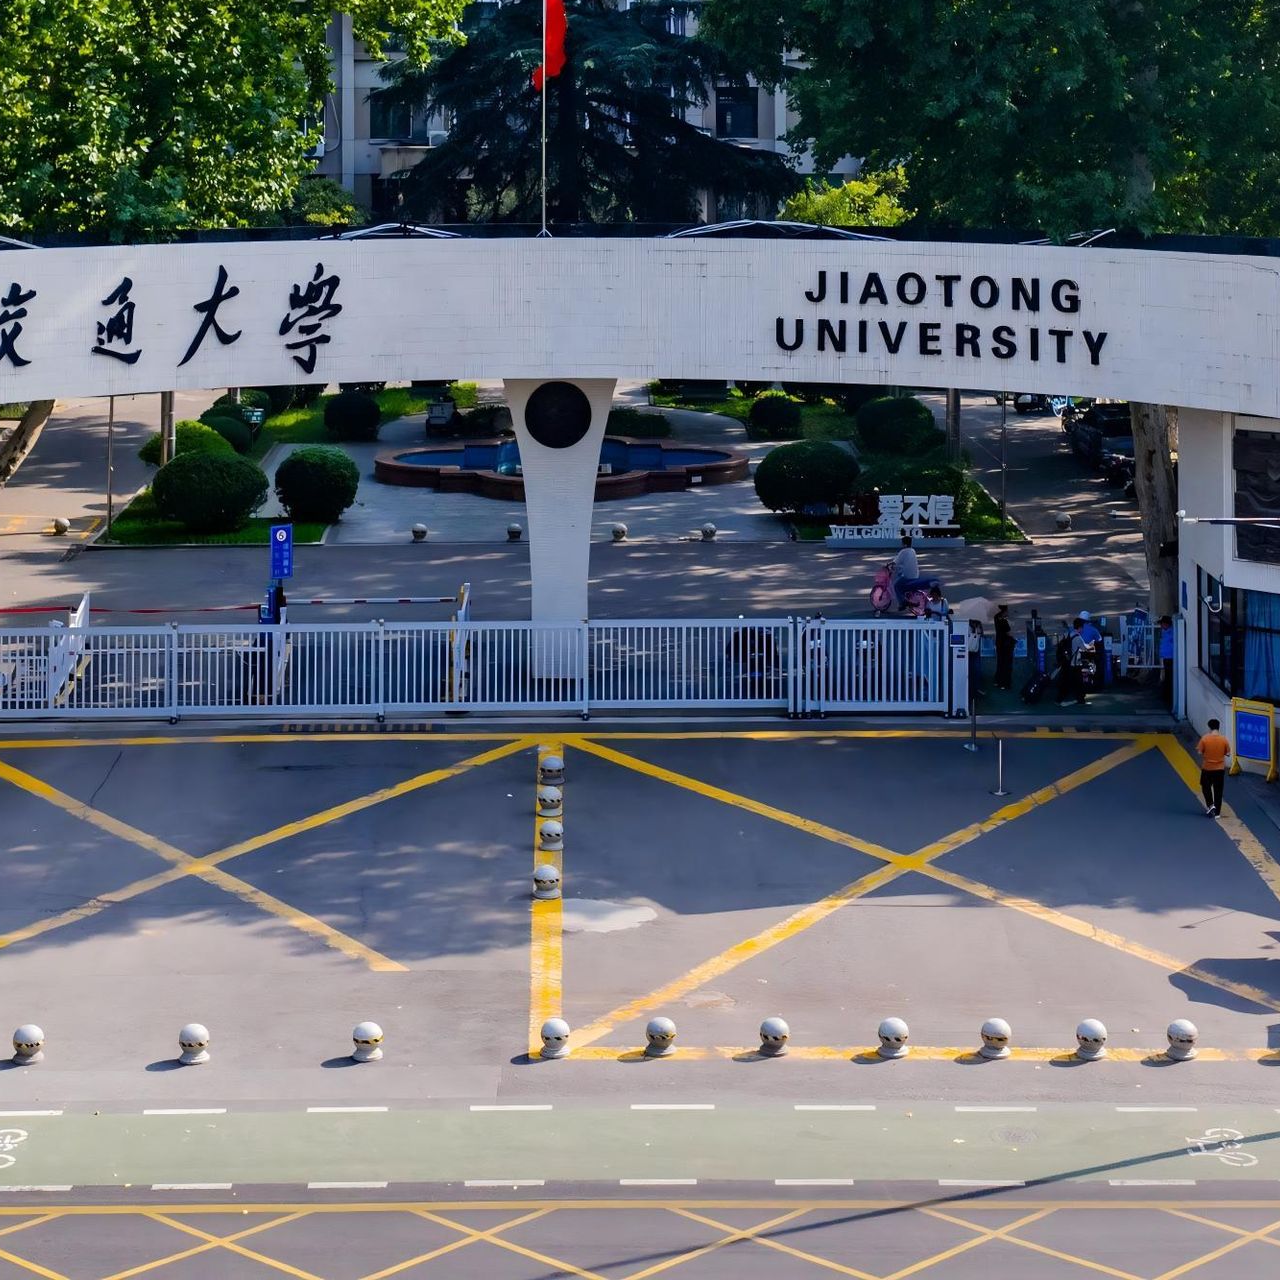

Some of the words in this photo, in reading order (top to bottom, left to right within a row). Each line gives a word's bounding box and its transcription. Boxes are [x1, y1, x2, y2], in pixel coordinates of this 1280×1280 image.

[804, 270, 1081, 313] JIAOTONG
[775, 317, 1108, 366] UNIVERSITY
[878, 494, 955, 526] 爱不停
[832, 526, 902, 540] WELCOME
[904, 526, 923, 540] TO
